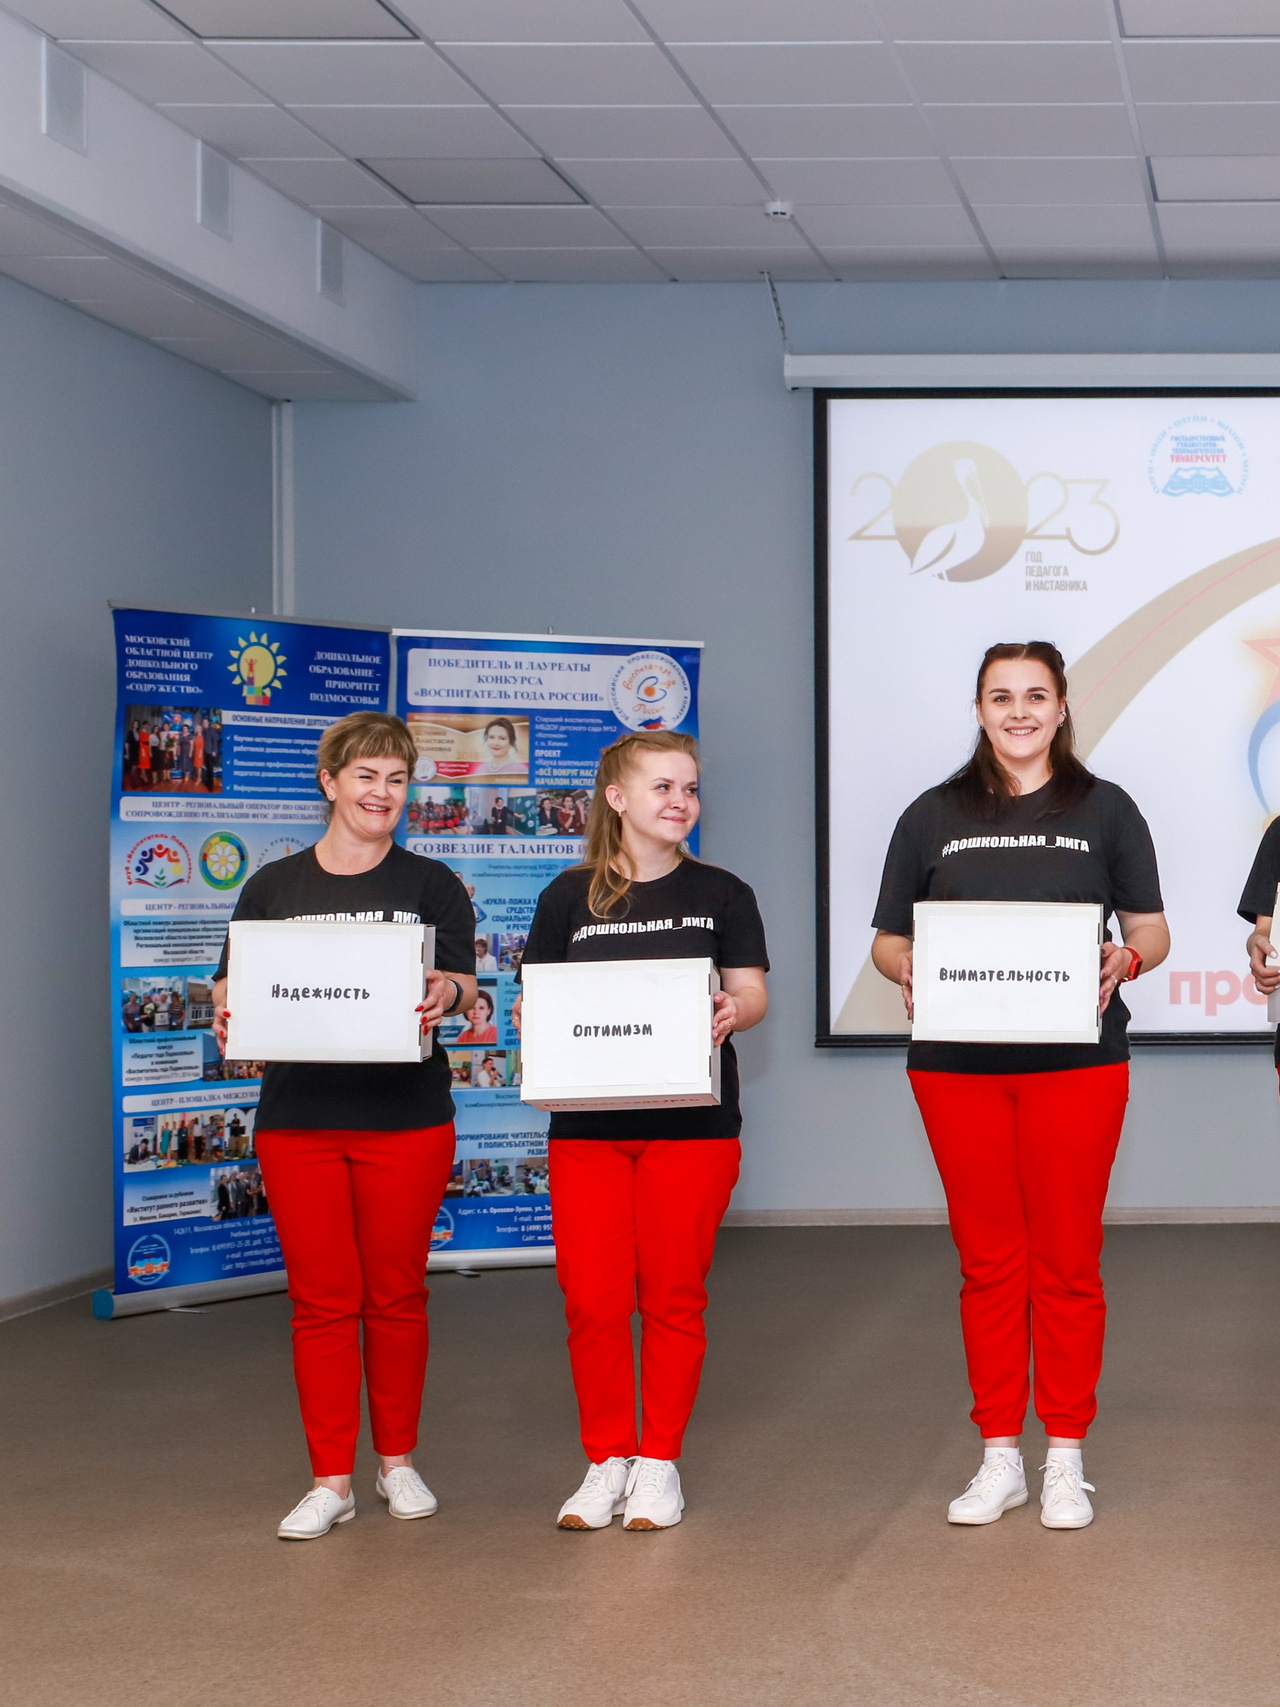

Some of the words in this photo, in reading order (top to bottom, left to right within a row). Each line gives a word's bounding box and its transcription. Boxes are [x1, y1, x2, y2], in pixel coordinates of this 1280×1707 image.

[1026, 552, 1042, 563] ГОД
[1026, 566, 1069, 577] ПЕДАГОГА
[1026, 580, 1031, 591] И
[1033, 580, 1088, 591] НАСТАВНИКА
[125, 635, 190, 646] МОСКОВСКИЙ
[125, 647, 181, 658] ОБЛАСТНОЙ
[183, 650, 214, 660] ЦЕНТР
[314, 651, 382, 664] ДОШКОЛЬНОЕ
[125, 659, 198, 670] ДОШКОЛЬНОГО
[428, 658, 511, 670] ПОБЕДИТЕЛЬ
[514, 662, 522, 670] И
[526, 662, 591, 672] ЛАУРЕАТЫ
[126, 671, 190, 682] ОБРАЗОВАНИЯ
[309, 665, 374, 677] ОБРАЗОВАНИЕ
[325, 680, 380, 691] ПРИОРИТЕТ
[477, 675, 543, 686] КОНКУРСА
[126, 683, 203, 693] «СОДРУЖЕСТВО»
[310, 693, 379, 705] ПОДМОСКОВЬЯ
[414, 688, 510, 699] «ВОСПИТАТЕЛЬ
[513, 691, 545, 701] ГОДА
[549, 692, 604, 702] РОССИИ»
[232, 714, 263, 723] ОСНОВНЫЕ
[553, 768, 578, 776] ВОКРУГ
[185, 802, 244, 810] РЕГИОНАЛЬНЫЙ
[126, 810, 199, 818] СОПРОВОЖДЕНИЮ
[413, 843, 495, 855] СОЗВЕЗДИЕ
[498, 844, 574, 854] ТАЛАНТОВ
[941, 835, 1089, 857] #ДОШКОЛЬНАЯ_ЛИГА
[572, 916, 714, 943] #ДОШКОЛЬНАЯ_ЛИГА
[939, 967, 1070, 983] Внимательность
[272, 984, 370, 1002] Надежность
[573, 1023, 652, 1037] Оптимизм
